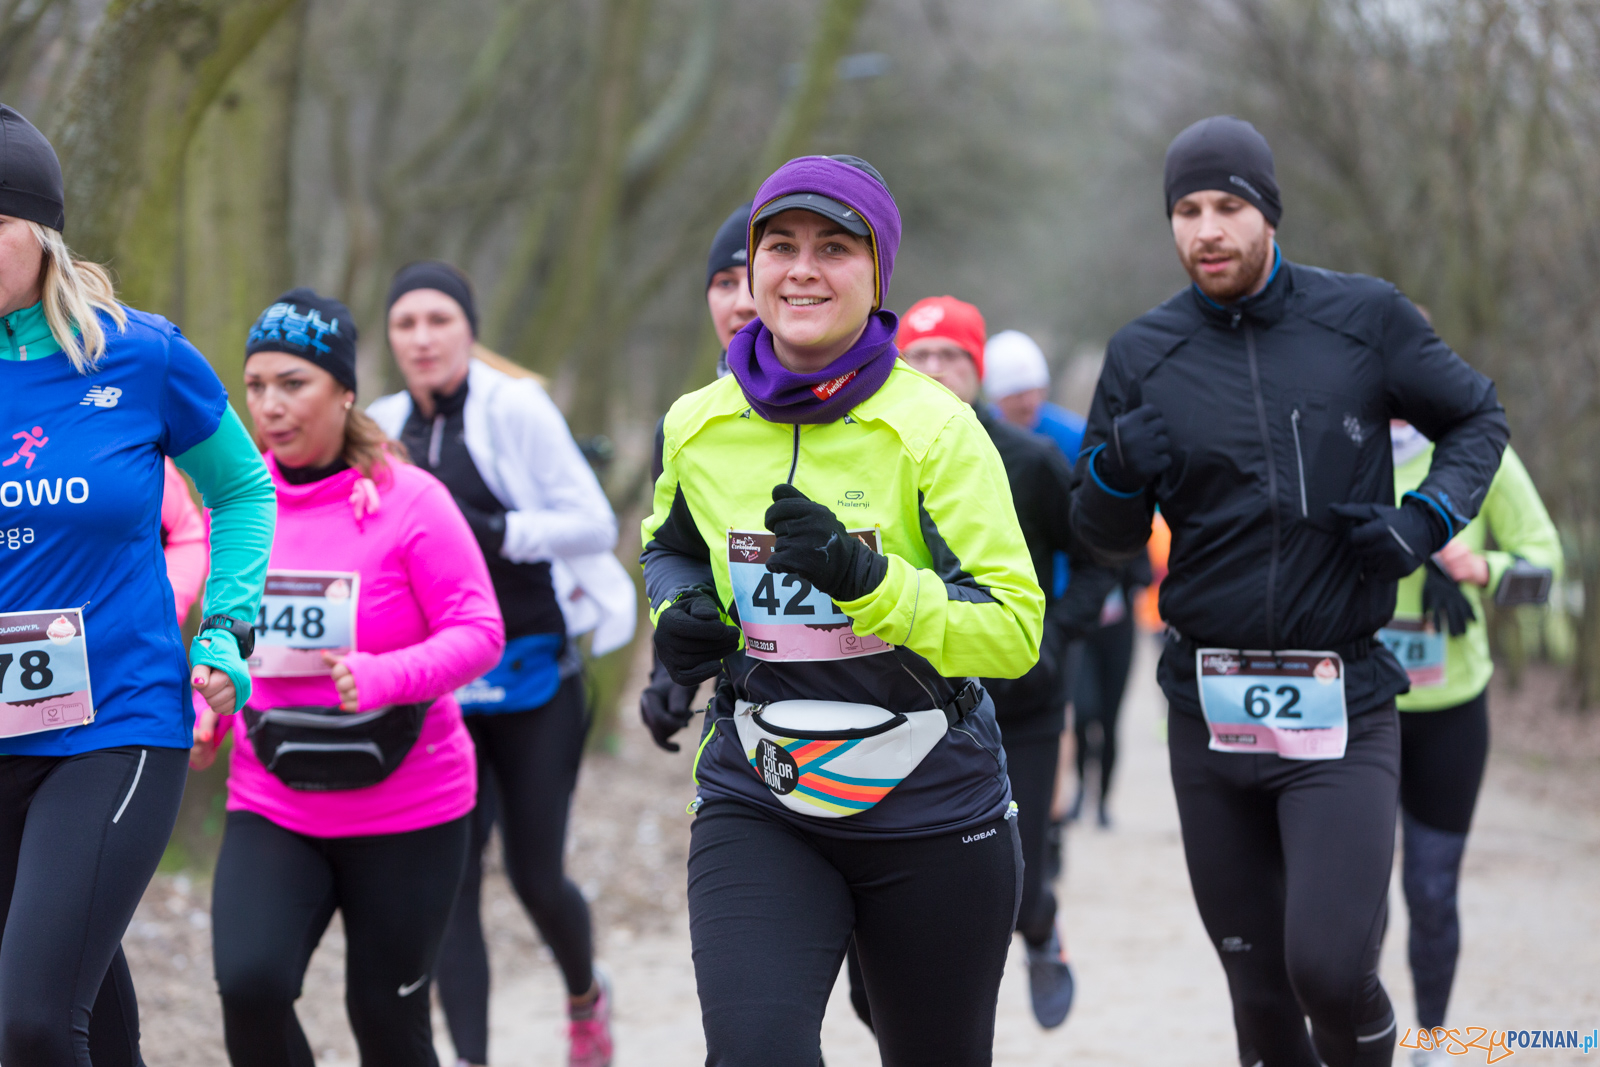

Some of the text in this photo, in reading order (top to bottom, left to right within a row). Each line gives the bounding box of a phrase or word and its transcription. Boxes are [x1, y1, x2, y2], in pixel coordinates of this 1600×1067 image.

[837, 499, 870, 509] Kalenji
[254, 605, 325, 638] 448
[1244, 685, 1303, 719] 62
[761, 739, 777, 762] THE
[762, 754, 793, 780] COLOR
